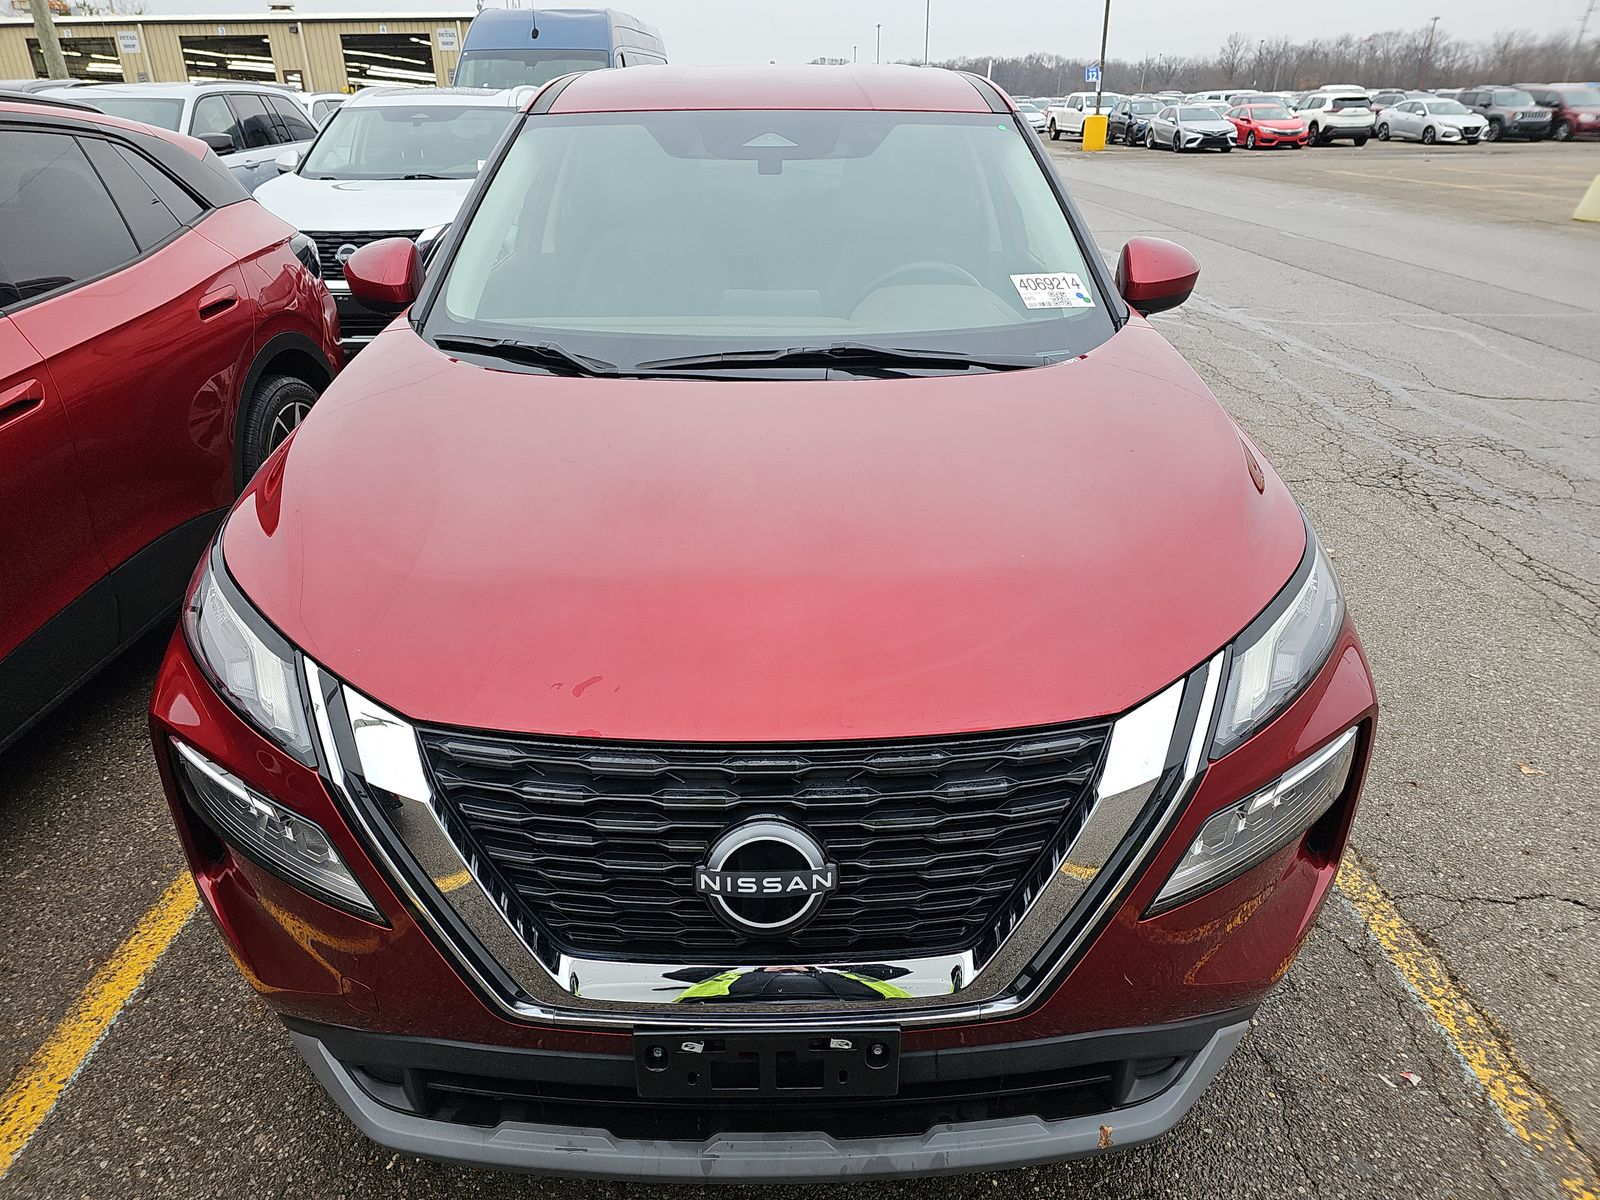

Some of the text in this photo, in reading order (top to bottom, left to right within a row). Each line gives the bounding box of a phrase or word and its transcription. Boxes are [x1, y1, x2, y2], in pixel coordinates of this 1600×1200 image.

[1088, 71, 1097, 81] 12
[1019, 276, 1080, 291] 4069214
[700, 871, 832, 894] NISSAN
